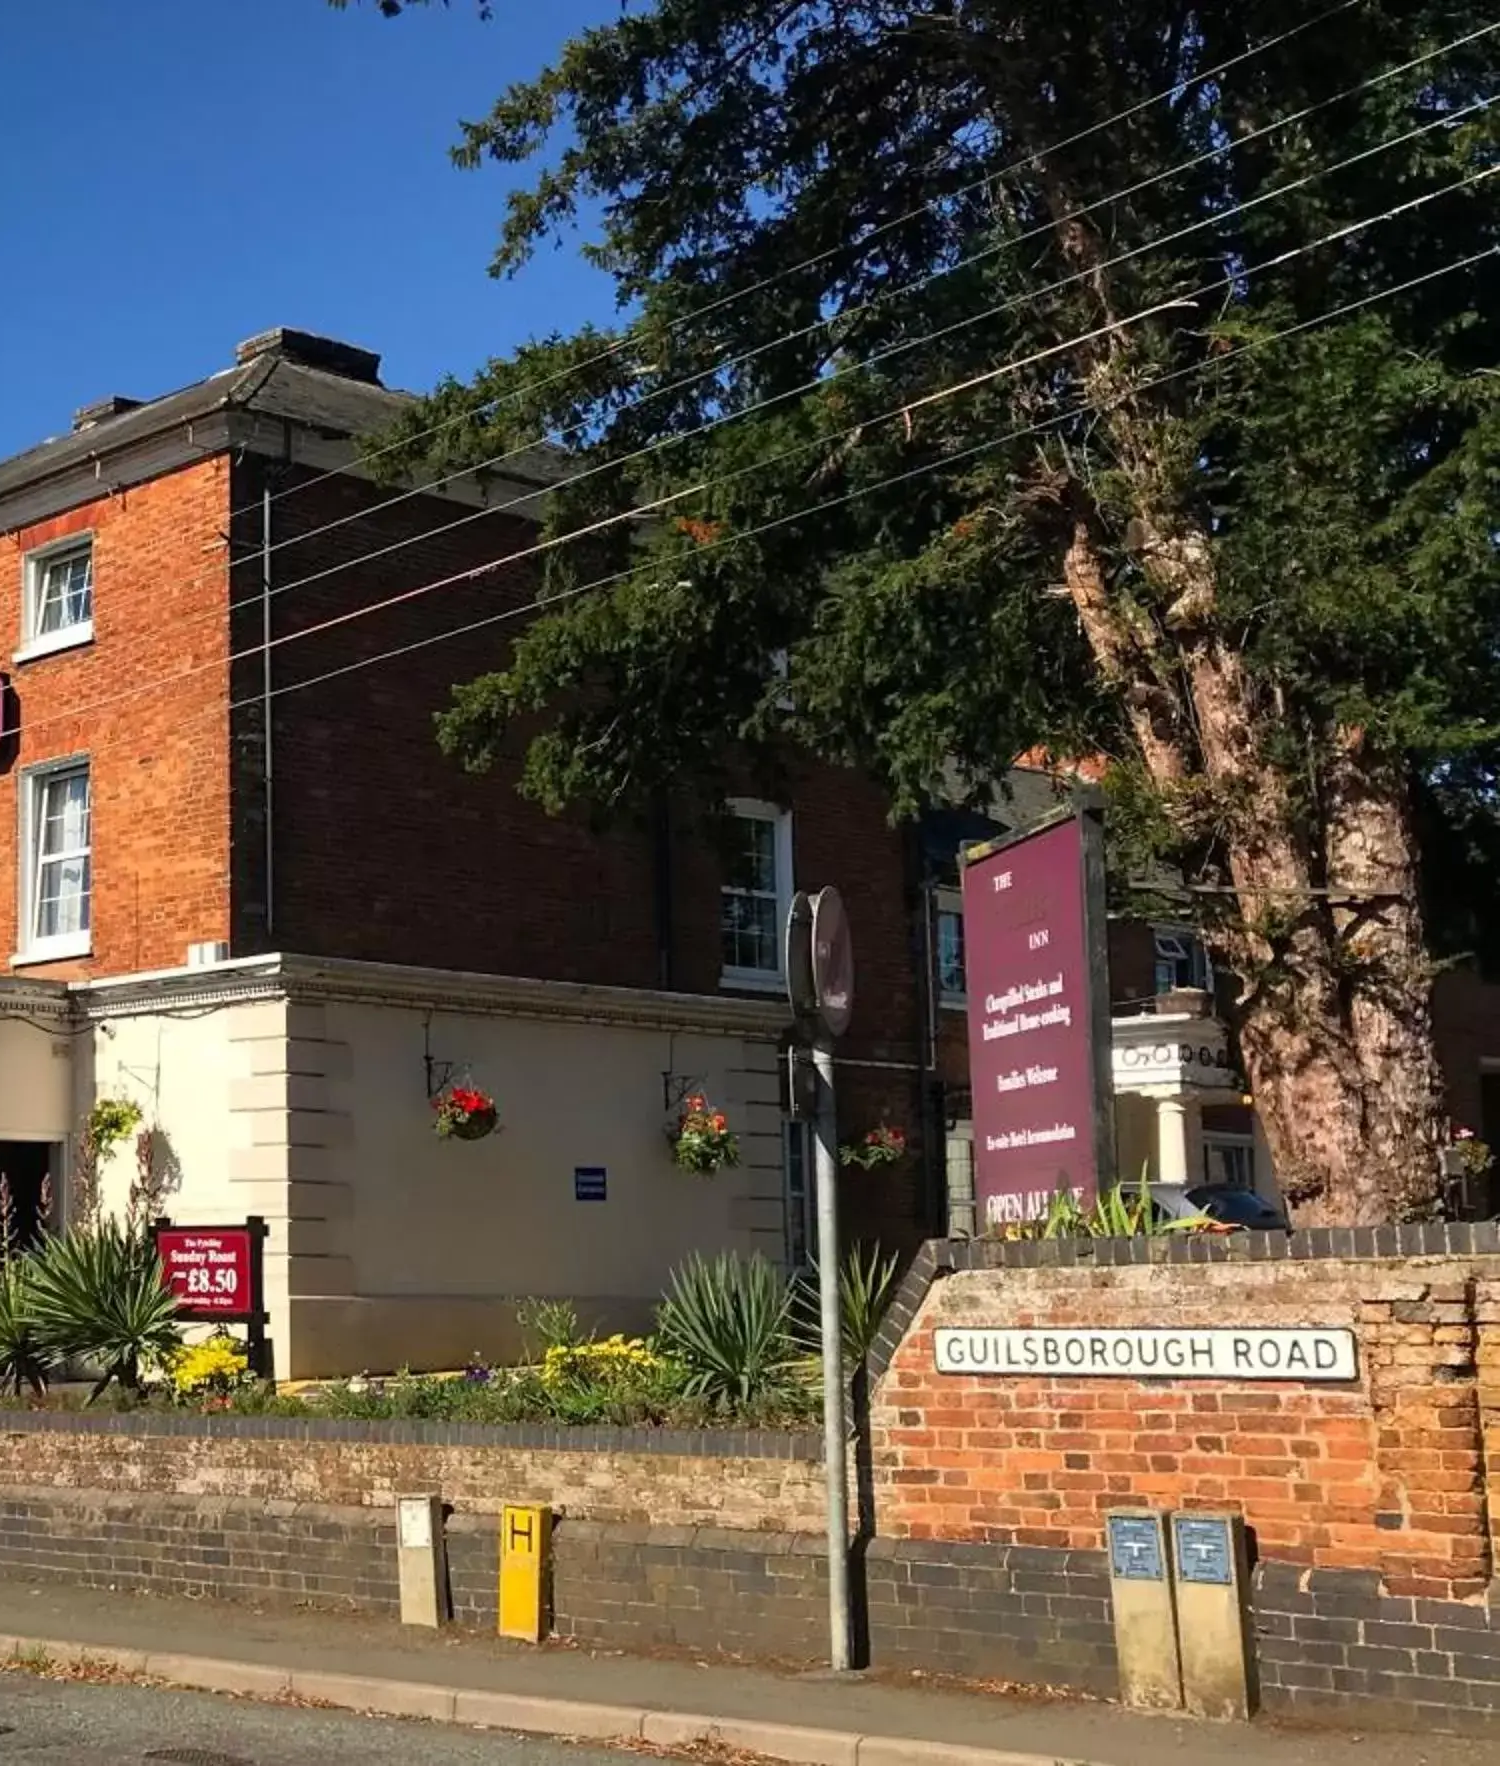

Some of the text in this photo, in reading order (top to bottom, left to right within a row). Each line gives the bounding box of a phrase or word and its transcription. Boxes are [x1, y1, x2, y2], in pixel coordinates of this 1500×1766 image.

[993, 871, 1013, 893] THE
[1029, 928, 1049, 951] INN
[1049, 972, 1063, 996] and
[986, 1192, 1023, 1223] OPEN
[171, 1249, 237, 1266] Sunday Roast
[188, 1268, 237, 1293] £8.50
[946, 1336, 1339, 1370] GUILSBOROUGH ROAD
[511, 1513, 533, 1553] H
